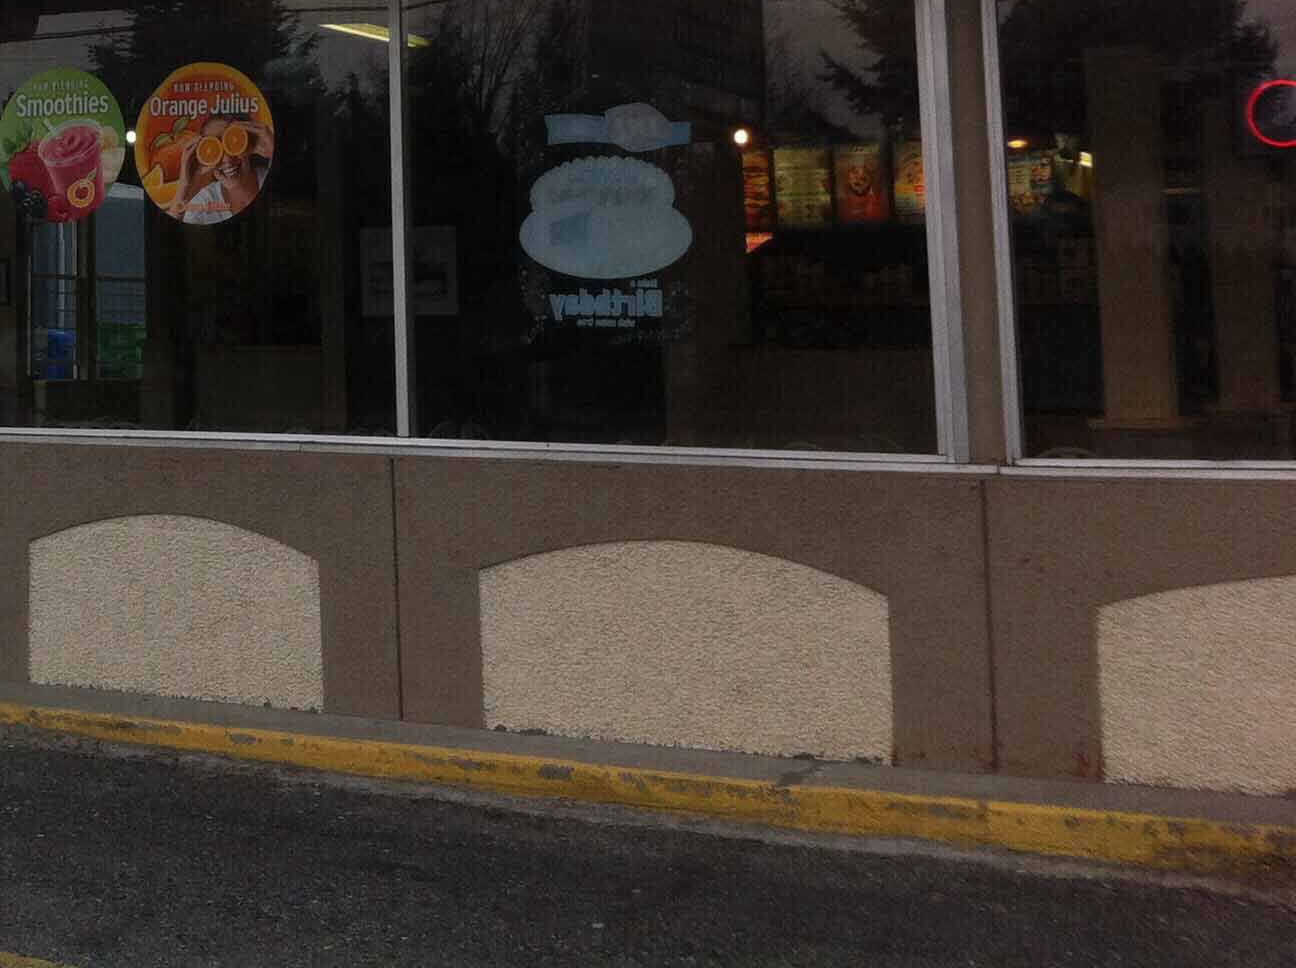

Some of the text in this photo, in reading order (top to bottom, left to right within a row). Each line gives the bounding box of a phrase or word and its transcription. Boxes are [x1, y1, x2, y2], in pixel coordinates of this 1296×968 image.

[15, 91, 109, 118] Smoothies
[150, 92, 259, 120] Orange Julius
